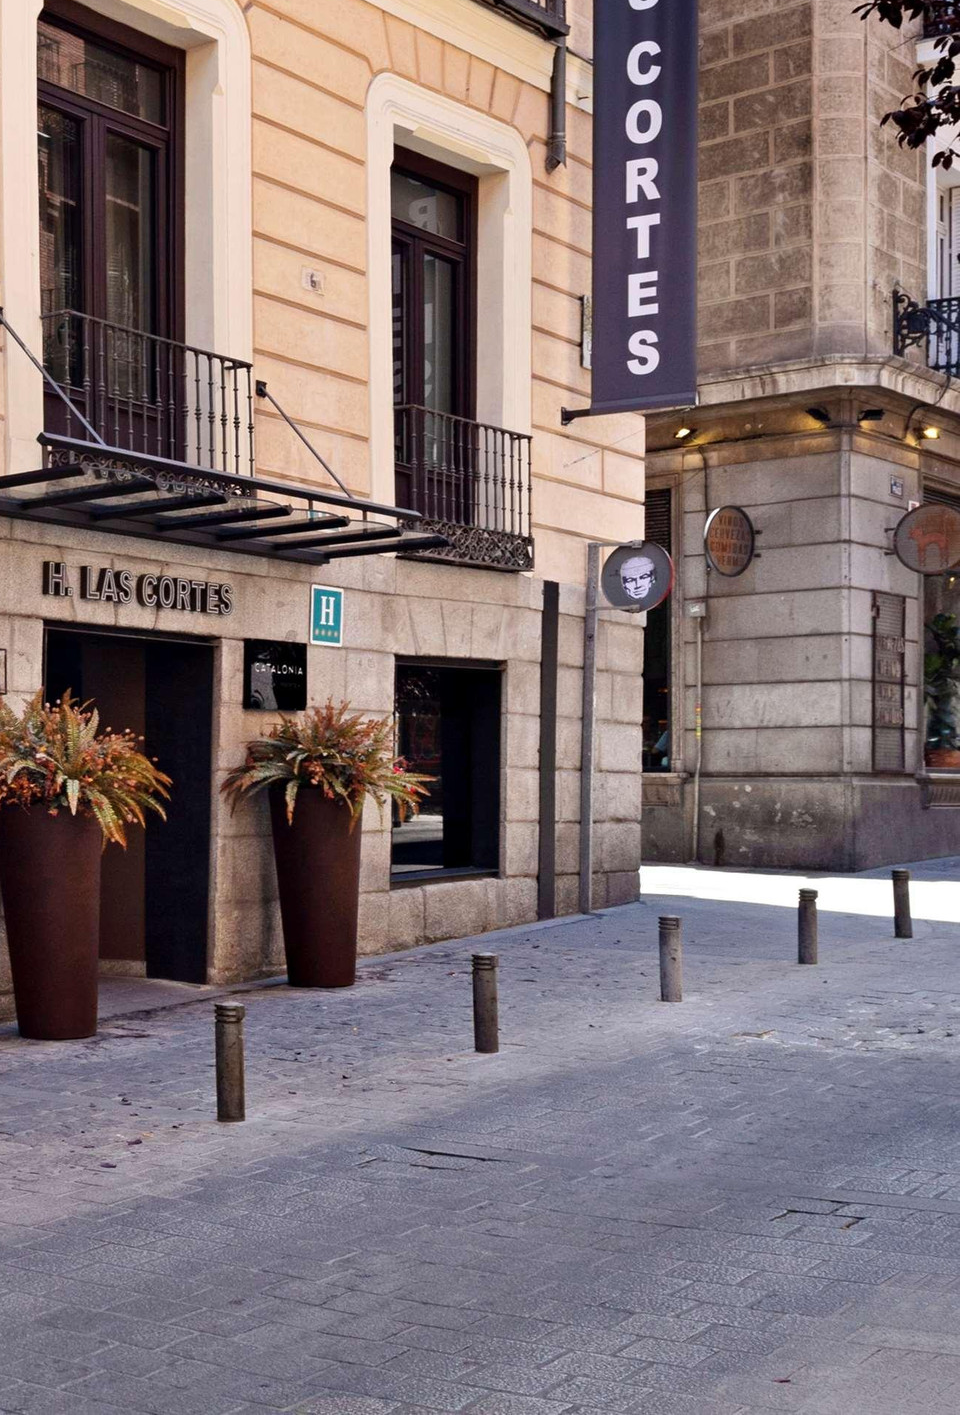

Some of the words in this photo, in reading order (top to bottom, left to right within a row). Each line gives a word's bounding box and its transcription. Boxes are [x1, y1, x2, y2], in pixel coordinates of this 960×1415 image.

[625, 40, 663, 375] CORTES
[43, 560, 73, 596] H.
[80, 565, 133, 605] LAS
[137, 572, 234, 615] CORTES
[319, 595, 336, 626] H
[254, 662, 303, 675] CATALONIA
